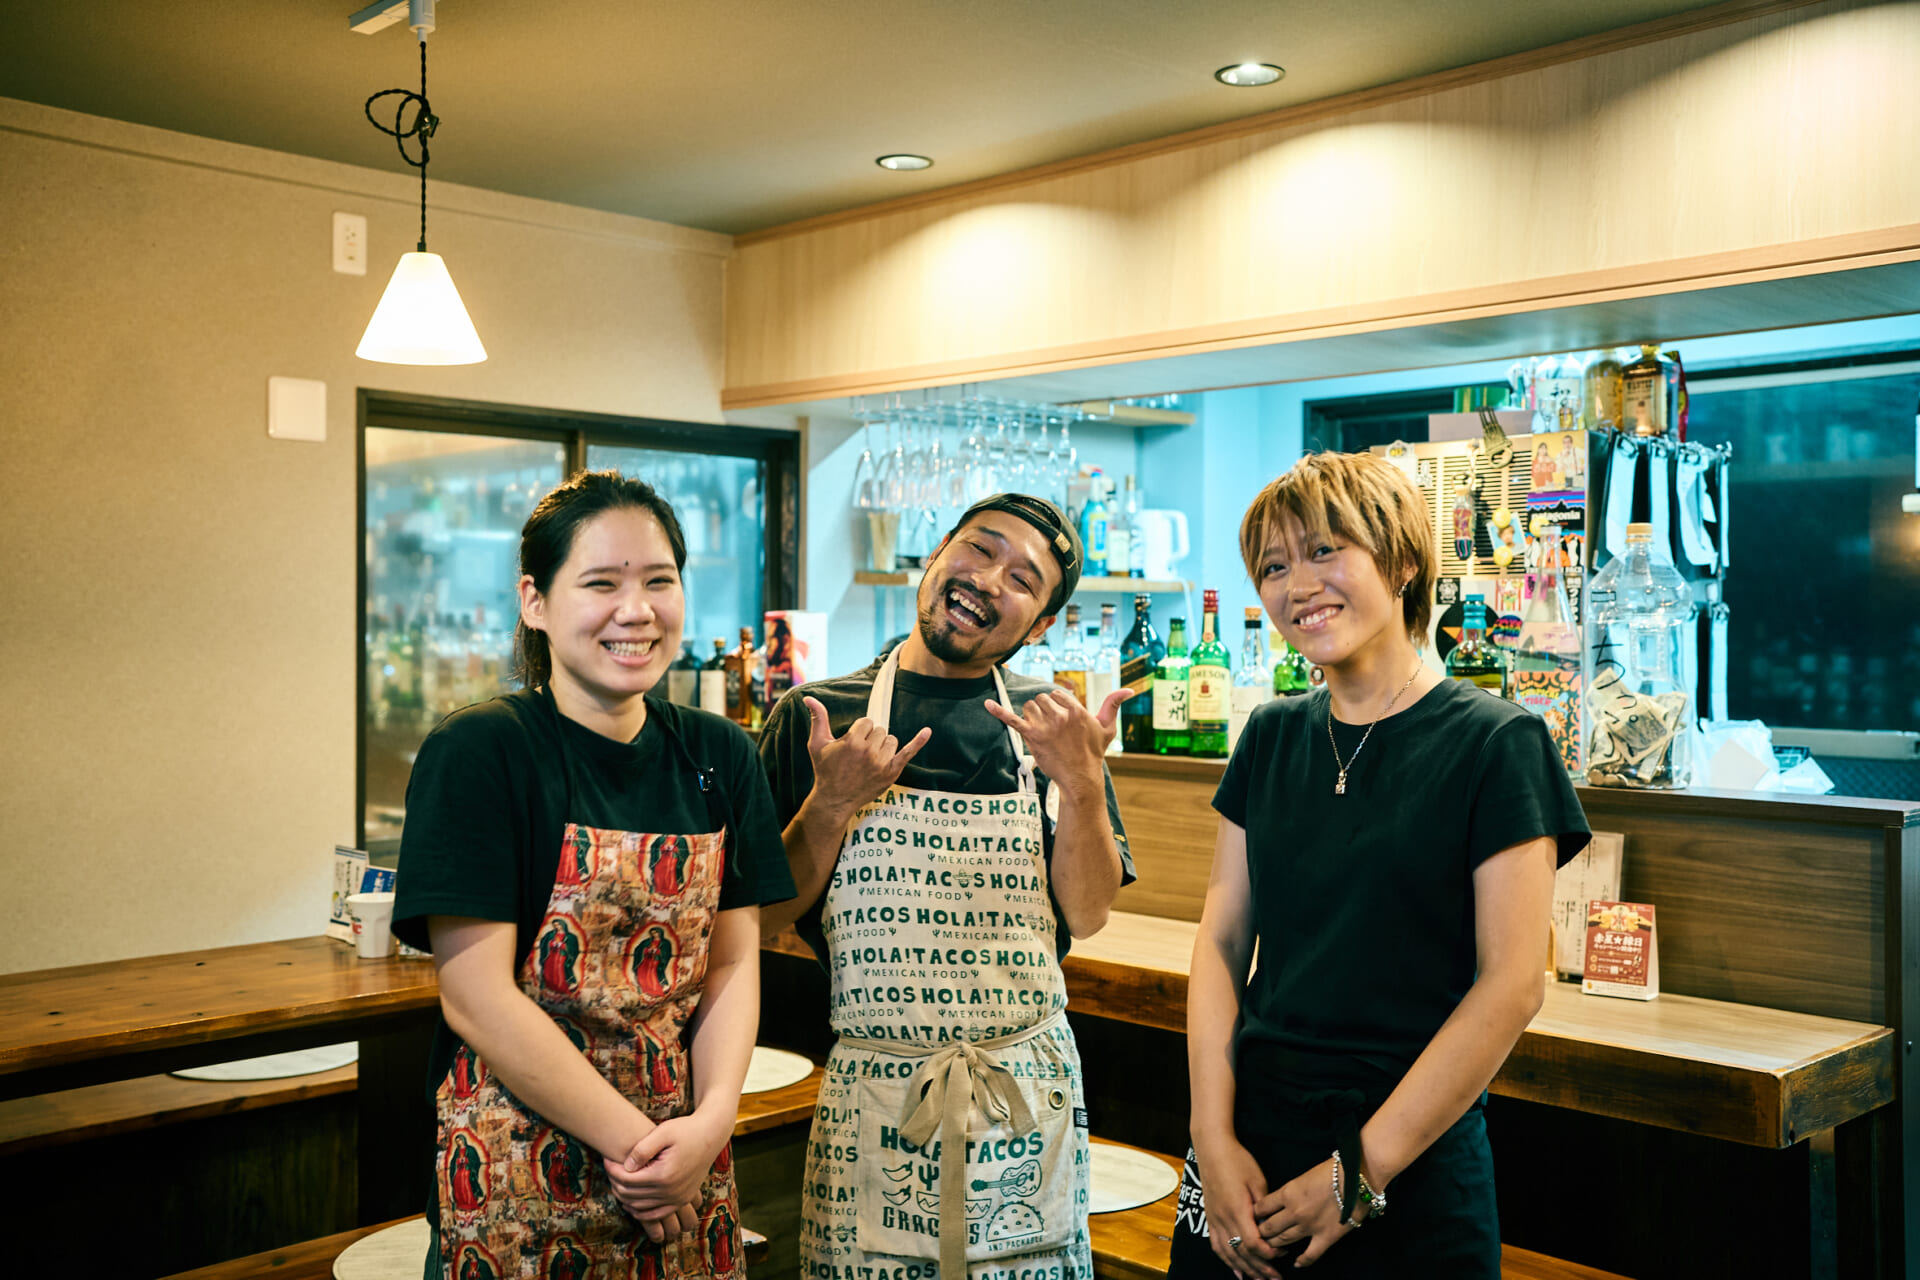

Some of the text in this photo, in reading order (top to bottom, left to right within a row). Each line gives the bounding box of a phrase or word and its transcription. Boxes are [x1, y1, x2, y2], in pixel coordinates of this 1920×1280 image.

[864, 809, 918, 822] MEXICAN
[925, 817, 958, 827] FOOD
[854, 848, 883, 860] FOOD
[938, 855, 992, 866] MEXICAN
[999, 857, 1029, 866] FOOD
[866, 887, 921, 897] MEXICAN
[928, 890, 962, 901] FOOD
[857, 929, 886, 937] FOOD
[943, 931, 998, 940] MEXICAN
[872, 968, 926, 977] MEXICAN
[933, 970, 968, 979] FOOD
[948, 1010, 1006, 1019] MEXICAN
